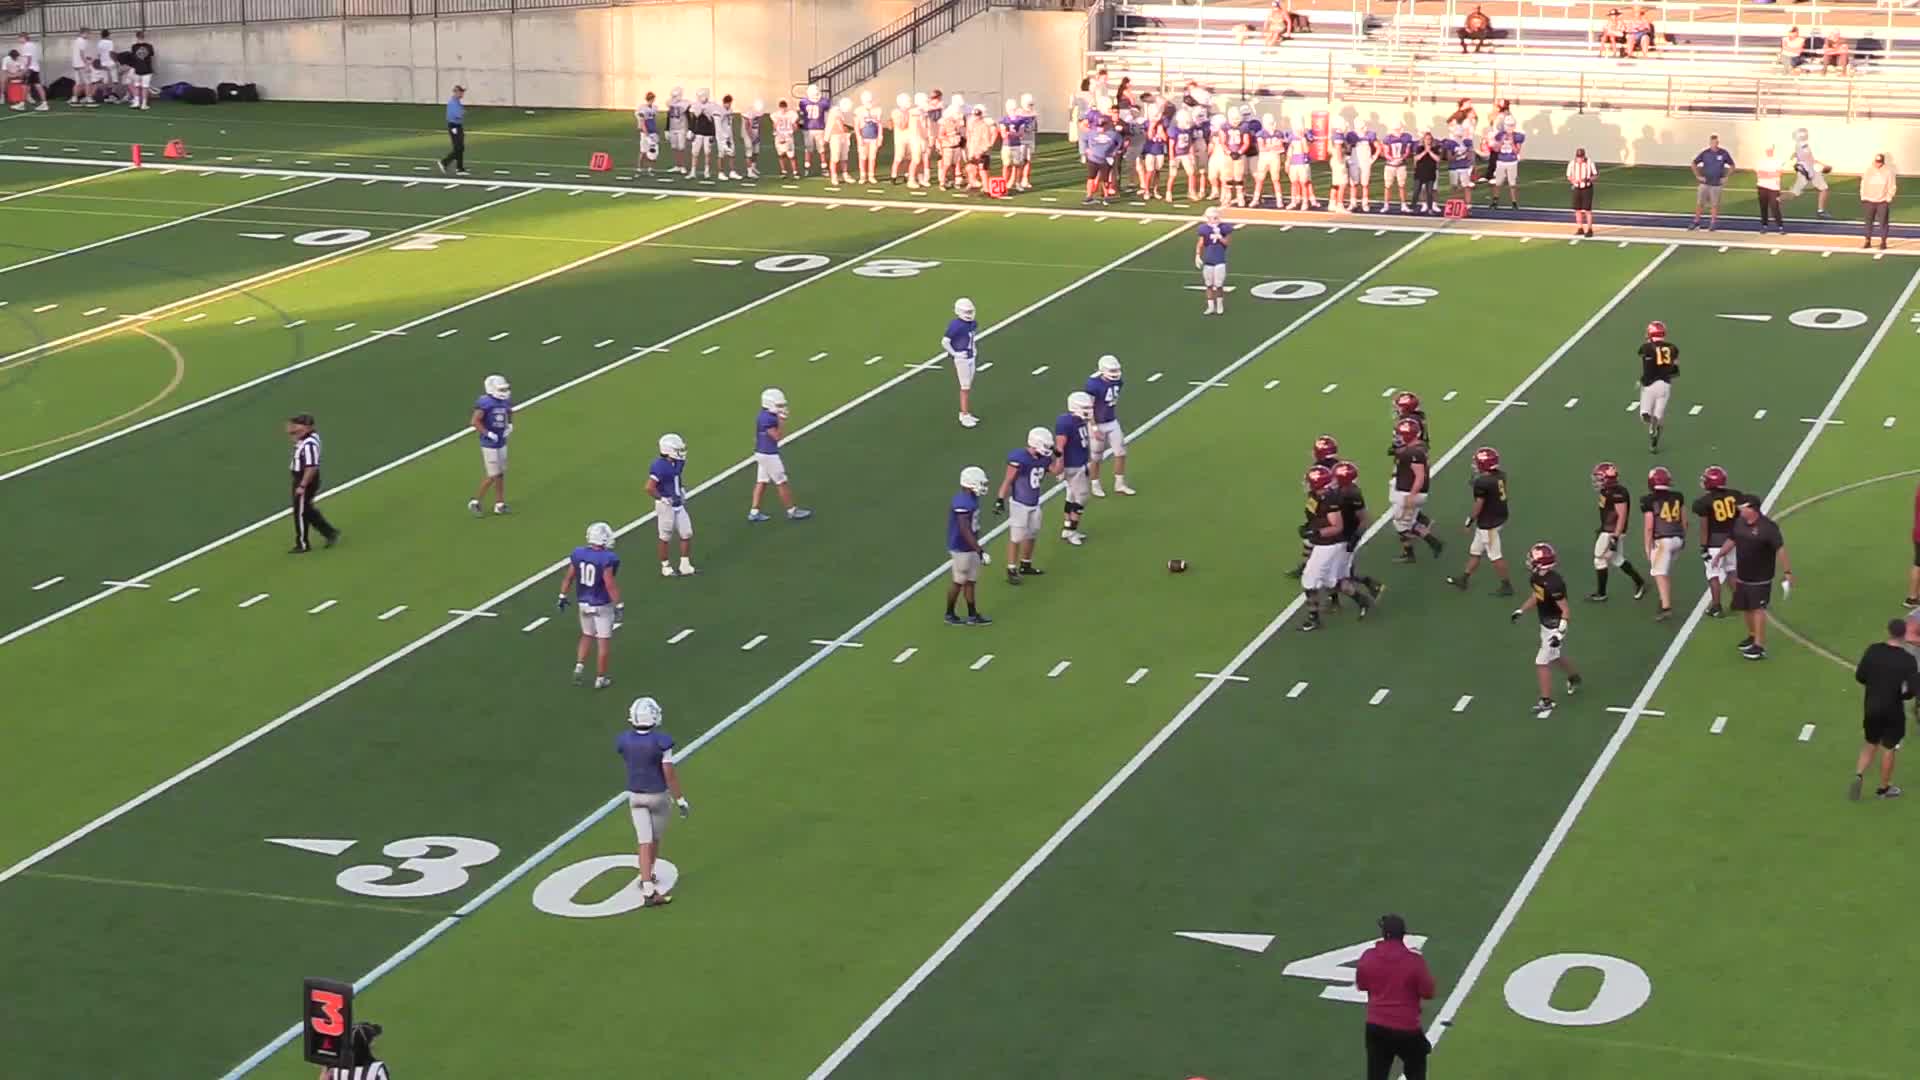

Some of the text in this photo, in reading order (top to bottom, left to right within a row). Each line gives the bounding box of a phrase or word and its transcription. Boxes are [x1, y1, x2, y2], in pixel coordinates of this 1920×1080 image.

[593, 155, 605, 168] 10
[991, 179, 1006, 195] 20
[1446, 201, 1461, 216] 30
[1655, 346, 1671, 365] 13
[1105, 387, 1121, 408] 45
[1660, 500, 1680, 522] 44
[1712, 496, 1736, 521] 80
[579, 562, 596, 587] 10
[310, 989, 345, 1037] 3
